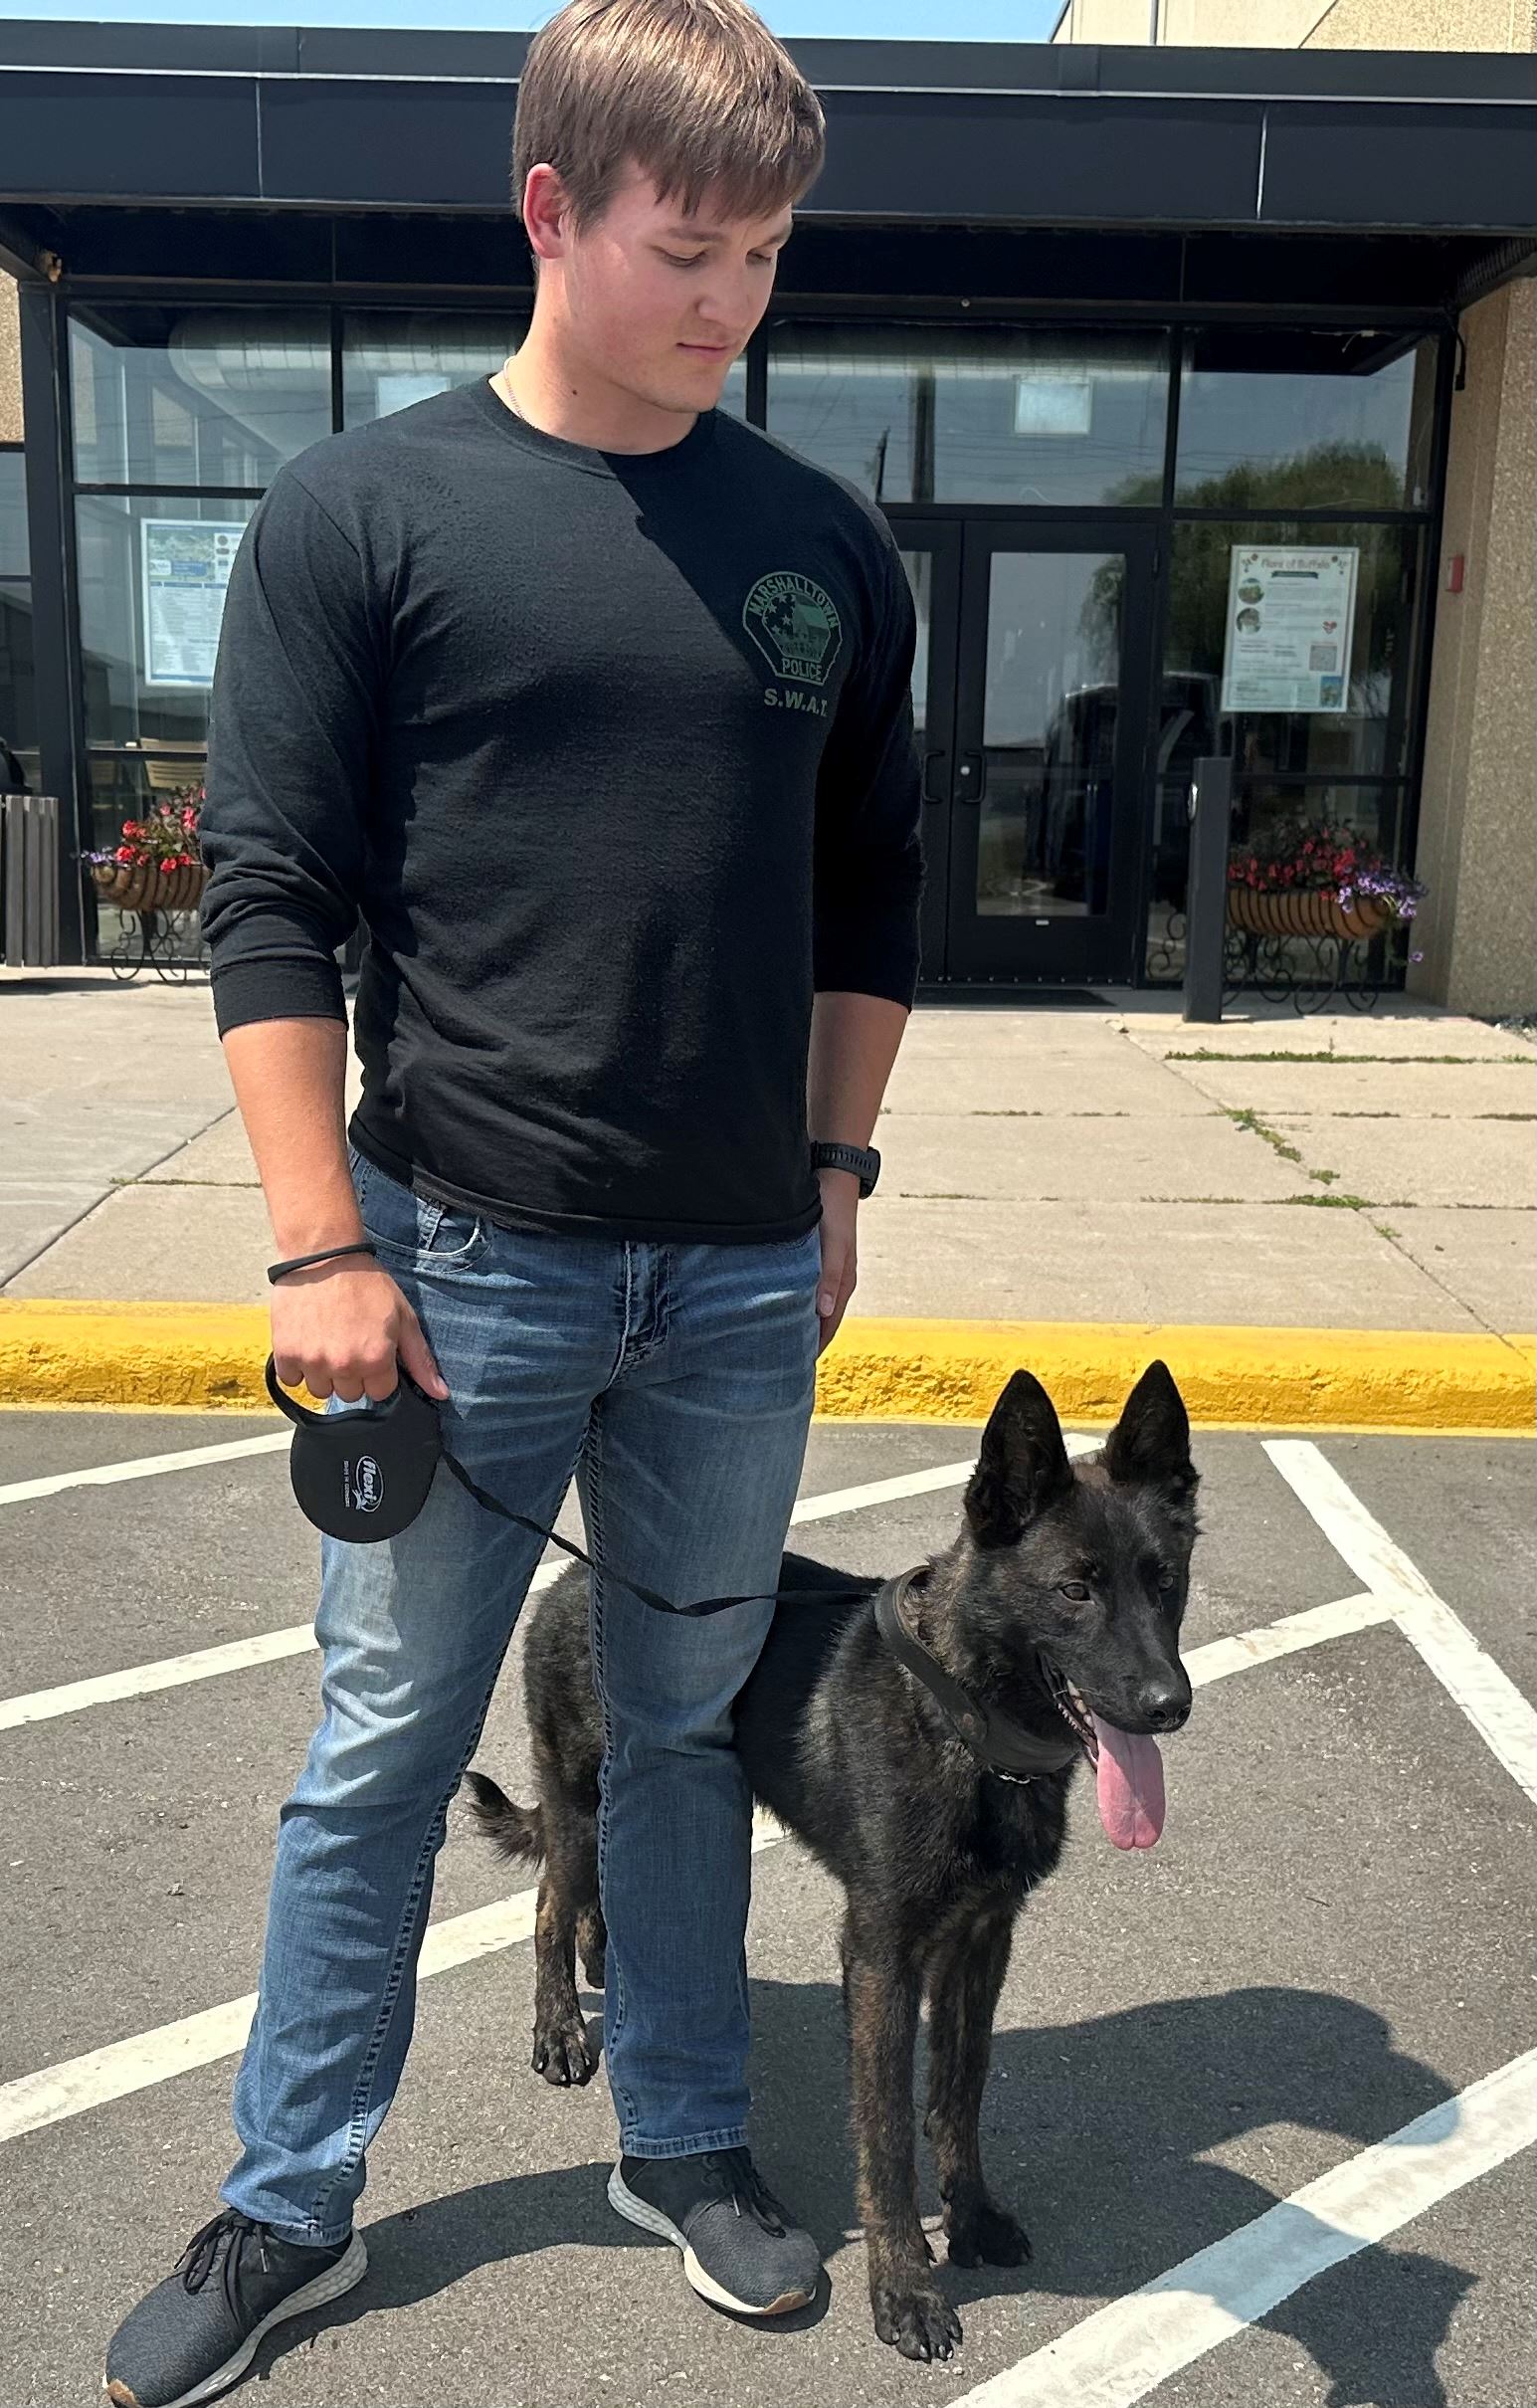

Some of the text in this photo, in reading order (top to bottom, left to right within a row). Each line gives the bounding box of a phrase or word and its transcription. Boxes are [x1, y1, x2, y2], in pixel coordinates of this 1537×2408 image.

[748, 577, 839, 628] MARSHALLTOWN
[782, 658, 822, 681] POLICE
[363, 1461, 377, 1501] flexi
